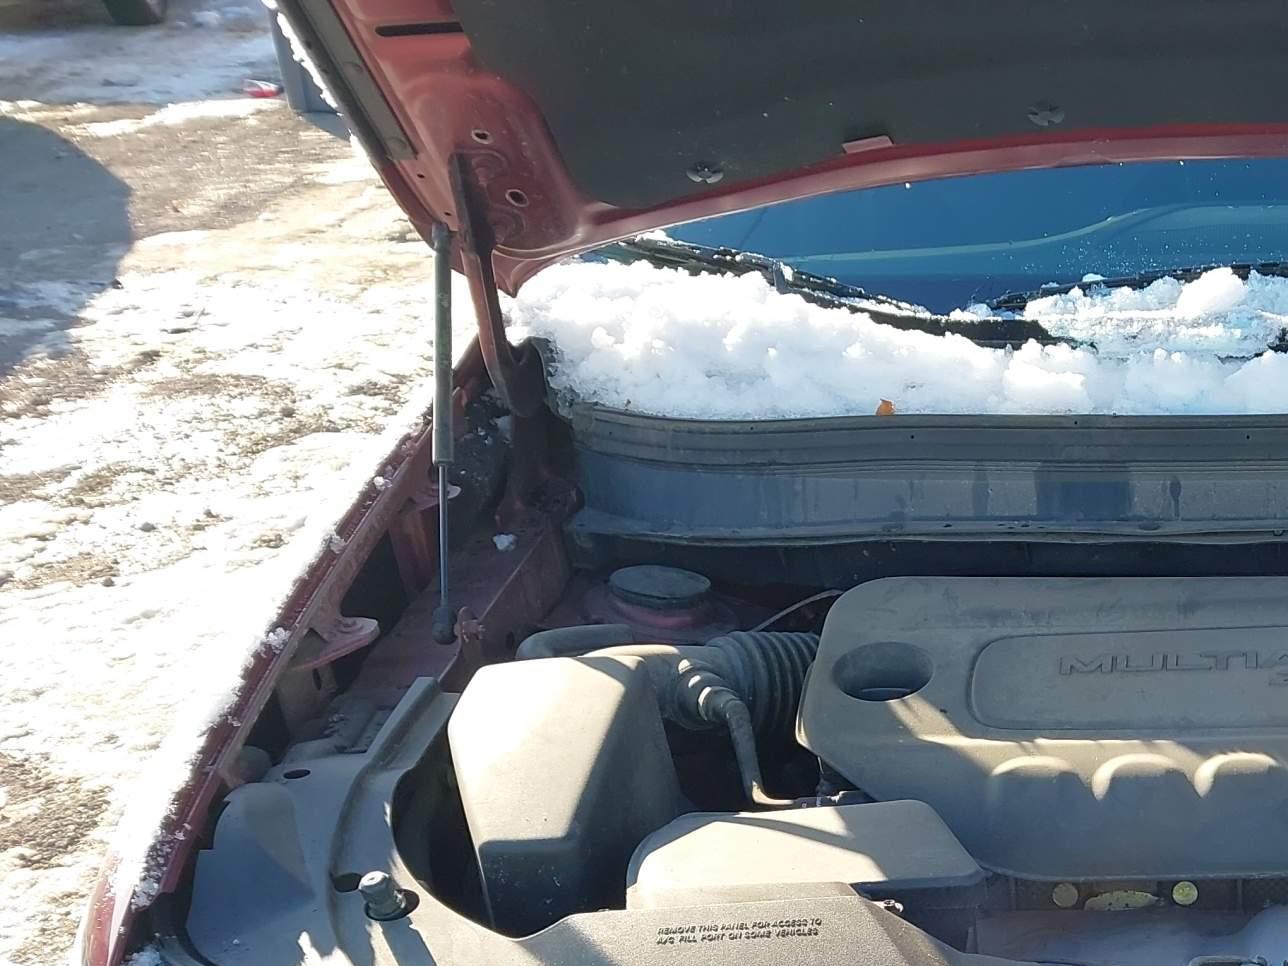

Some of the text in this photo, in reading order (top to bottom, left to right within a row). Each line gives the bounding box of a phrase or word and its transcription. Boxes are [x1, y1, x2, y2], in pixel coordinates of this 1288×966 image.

[657, 918, 822, 936] REMOVE THIS PANEL FOR ACCESS TO
[656, 928, 819, 945] A/C FILL PORT ON SOME VEHICLES
